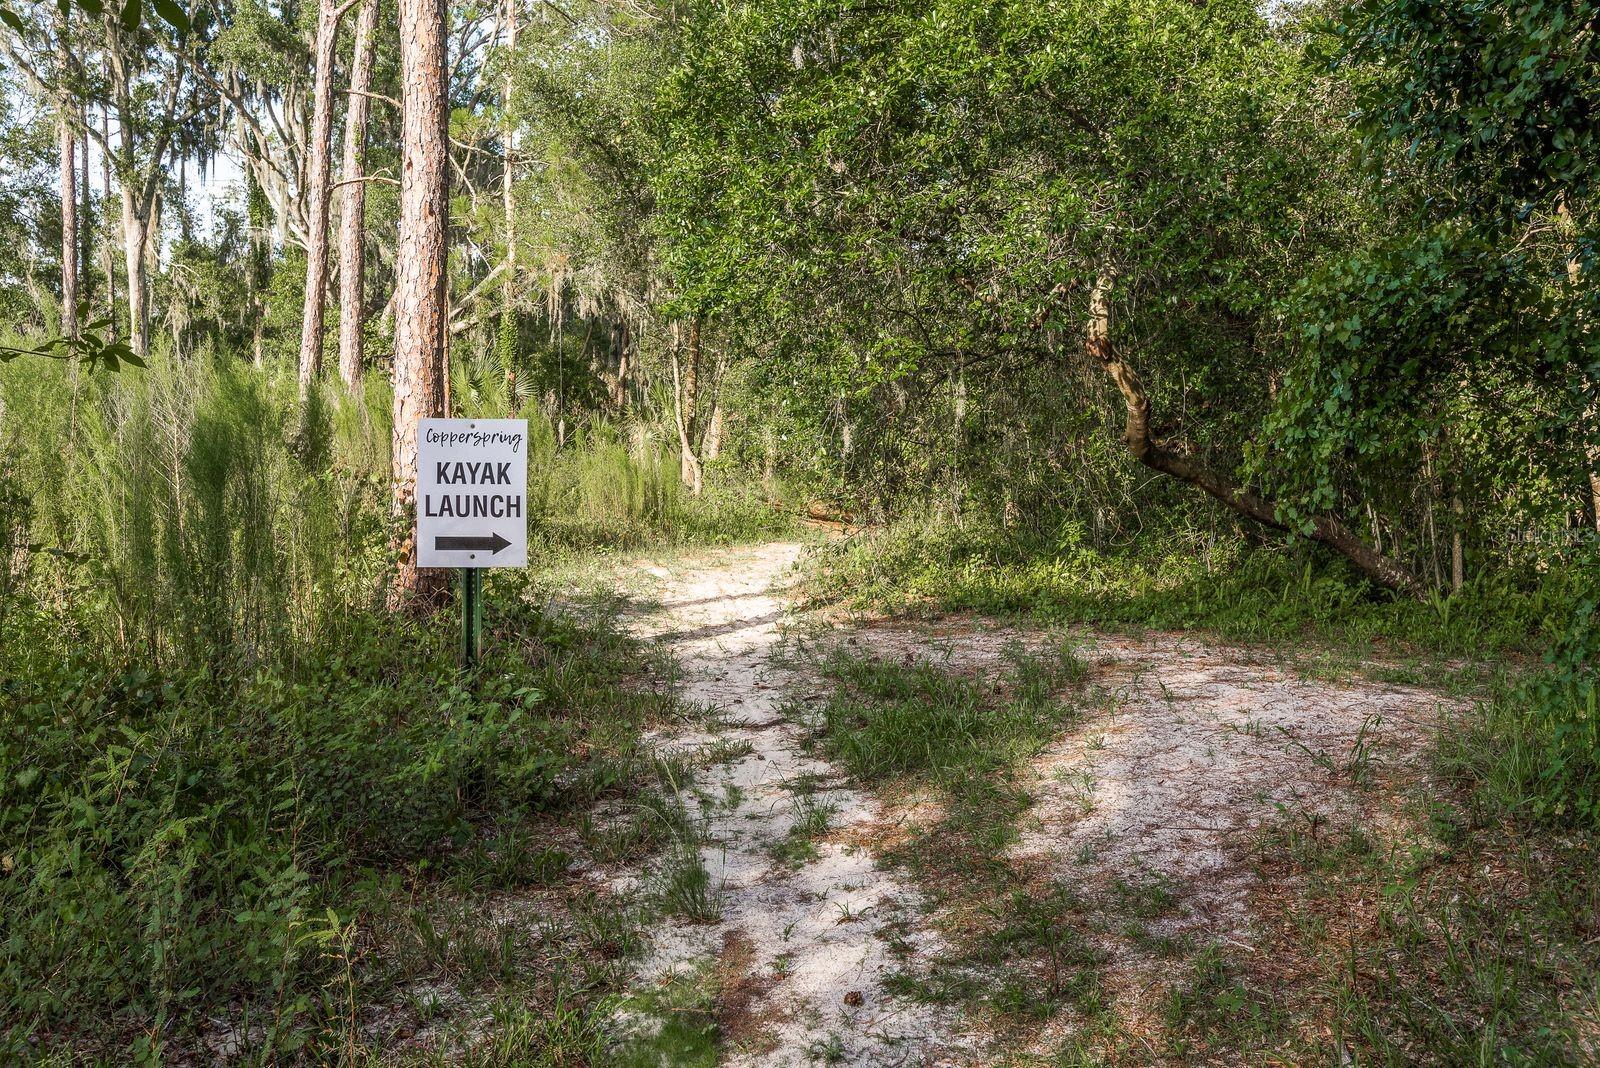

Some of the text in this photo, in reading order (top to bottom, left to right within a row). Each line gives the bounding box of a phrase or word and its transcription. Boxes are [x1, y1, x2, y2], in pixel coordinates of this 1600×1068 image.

[426, 428, 522, 453] Copperspring
[436, 462, 511, 485] KAYAK
[425, 495, 521, 518] LAUNCH
